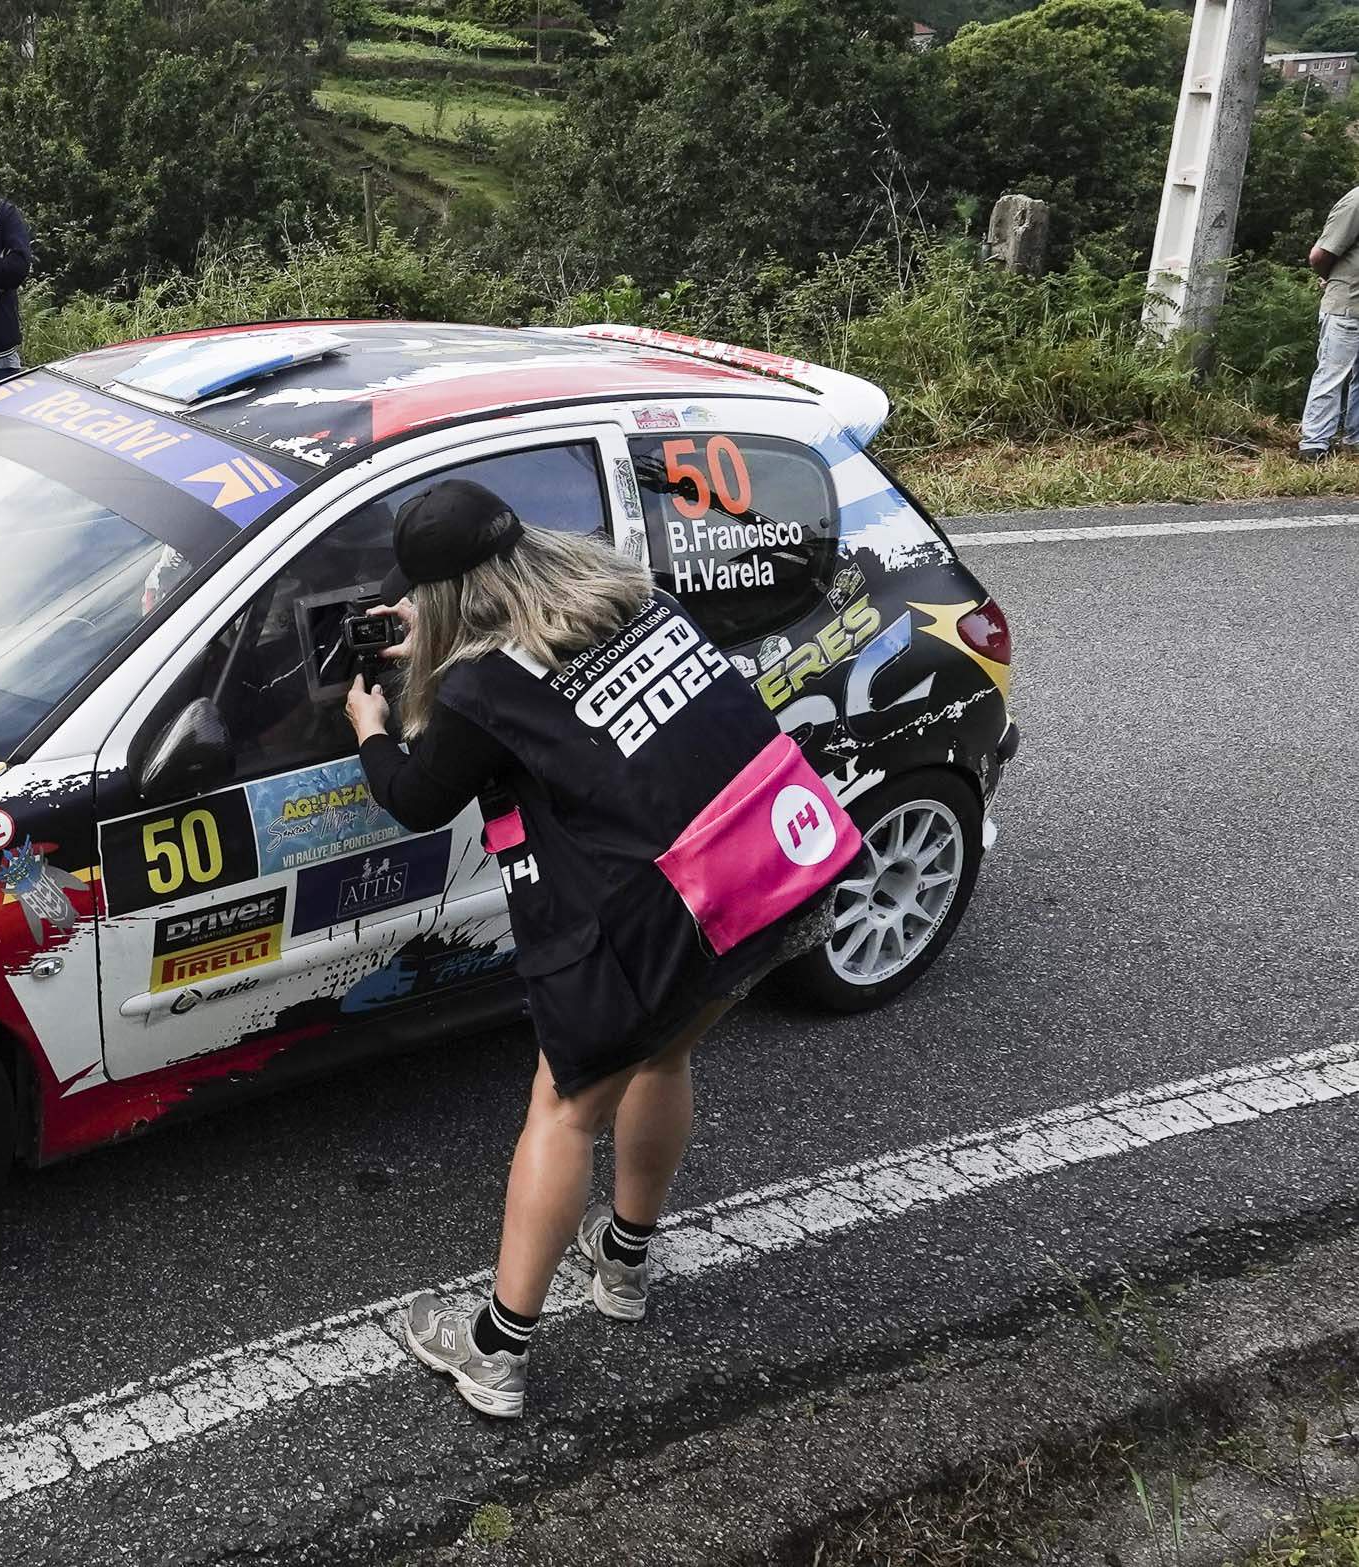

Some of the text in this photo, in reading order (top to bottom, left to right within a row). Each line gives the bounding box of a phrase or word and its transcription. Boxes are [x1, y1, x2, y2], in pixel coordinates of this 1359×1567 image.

[18, 389, 192, 461] Recalvi
[662, 434, 752, 519] 50
[667, 516, 803, 554] B.Francisco
[673, 554, 775, 593] H.Varela
[549, 625, 626, 691] FEDERAC
[563, 677, 586, 700] DE
[584, 606, 672, 683] AUTOMOBILISMO
[750, 593, 882, 712] ERES
[608, 641, 732, 759] 2025
[143, 809, 222, 894] 50
[282, 826, 401, 867] VII RALLYE DE PONTEVEDRA
[785, 801, 820, 850] 14
[343, 871, 403, 906] ATTIS
[166, 896, 277, 942] Driver
[161, 932, 272, 985] PIRELLI
